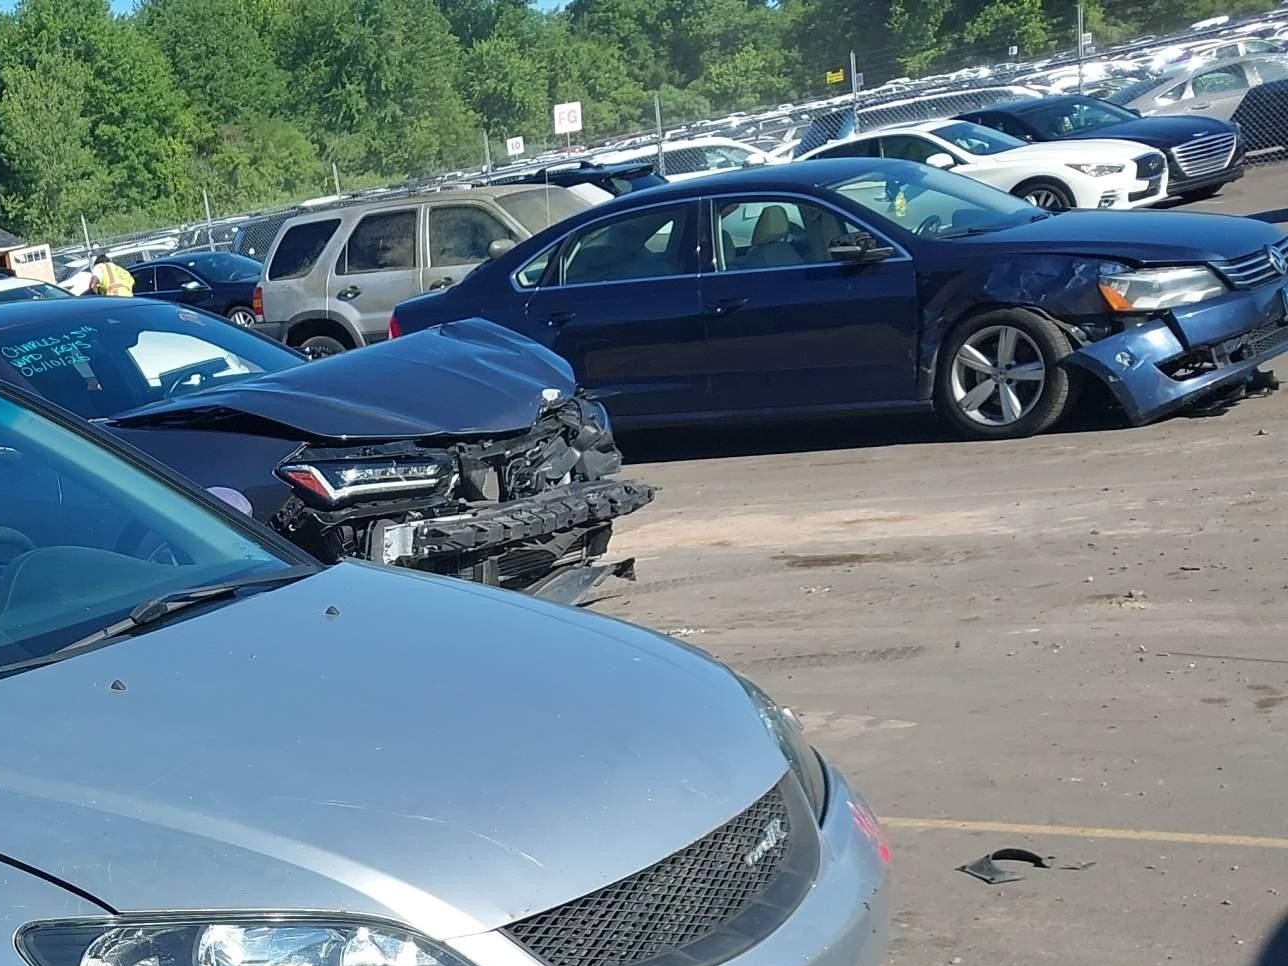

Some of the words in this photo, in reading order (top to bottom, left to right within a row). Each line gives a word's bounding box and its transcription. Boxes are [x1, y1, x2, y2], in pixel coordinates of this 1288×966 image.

[558, 109, 578, 126] FG
[511, 141, 521, 151] 10
[1, 336, 60, 358] CHARLES
[50, 340, 92, 356] KEYS
